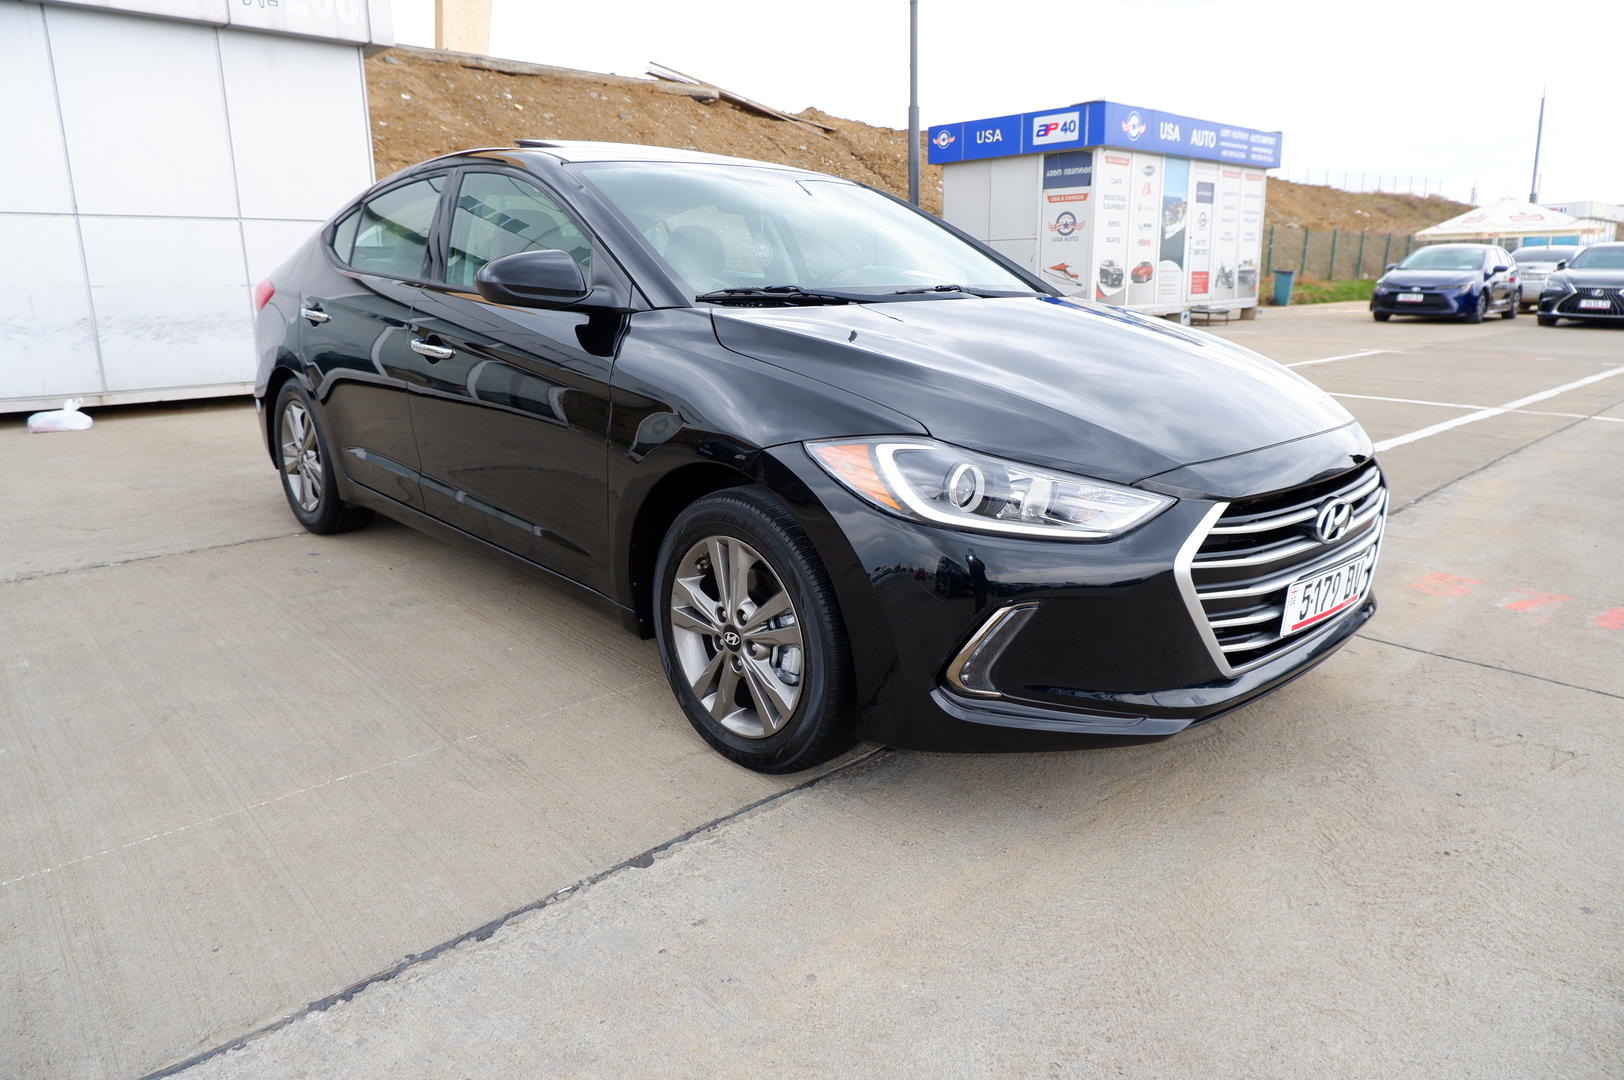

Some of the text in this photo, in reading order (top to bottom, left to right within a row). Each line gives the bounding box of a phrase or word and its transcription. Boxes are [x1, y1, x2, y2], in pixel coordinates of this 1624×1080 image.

[1060, 119, 1076, 134] 40
[976, 129, 1003, 144] USA
[1160, 121, 1181, 142] USA
[1190, 128, 1216, 148] AUTO
